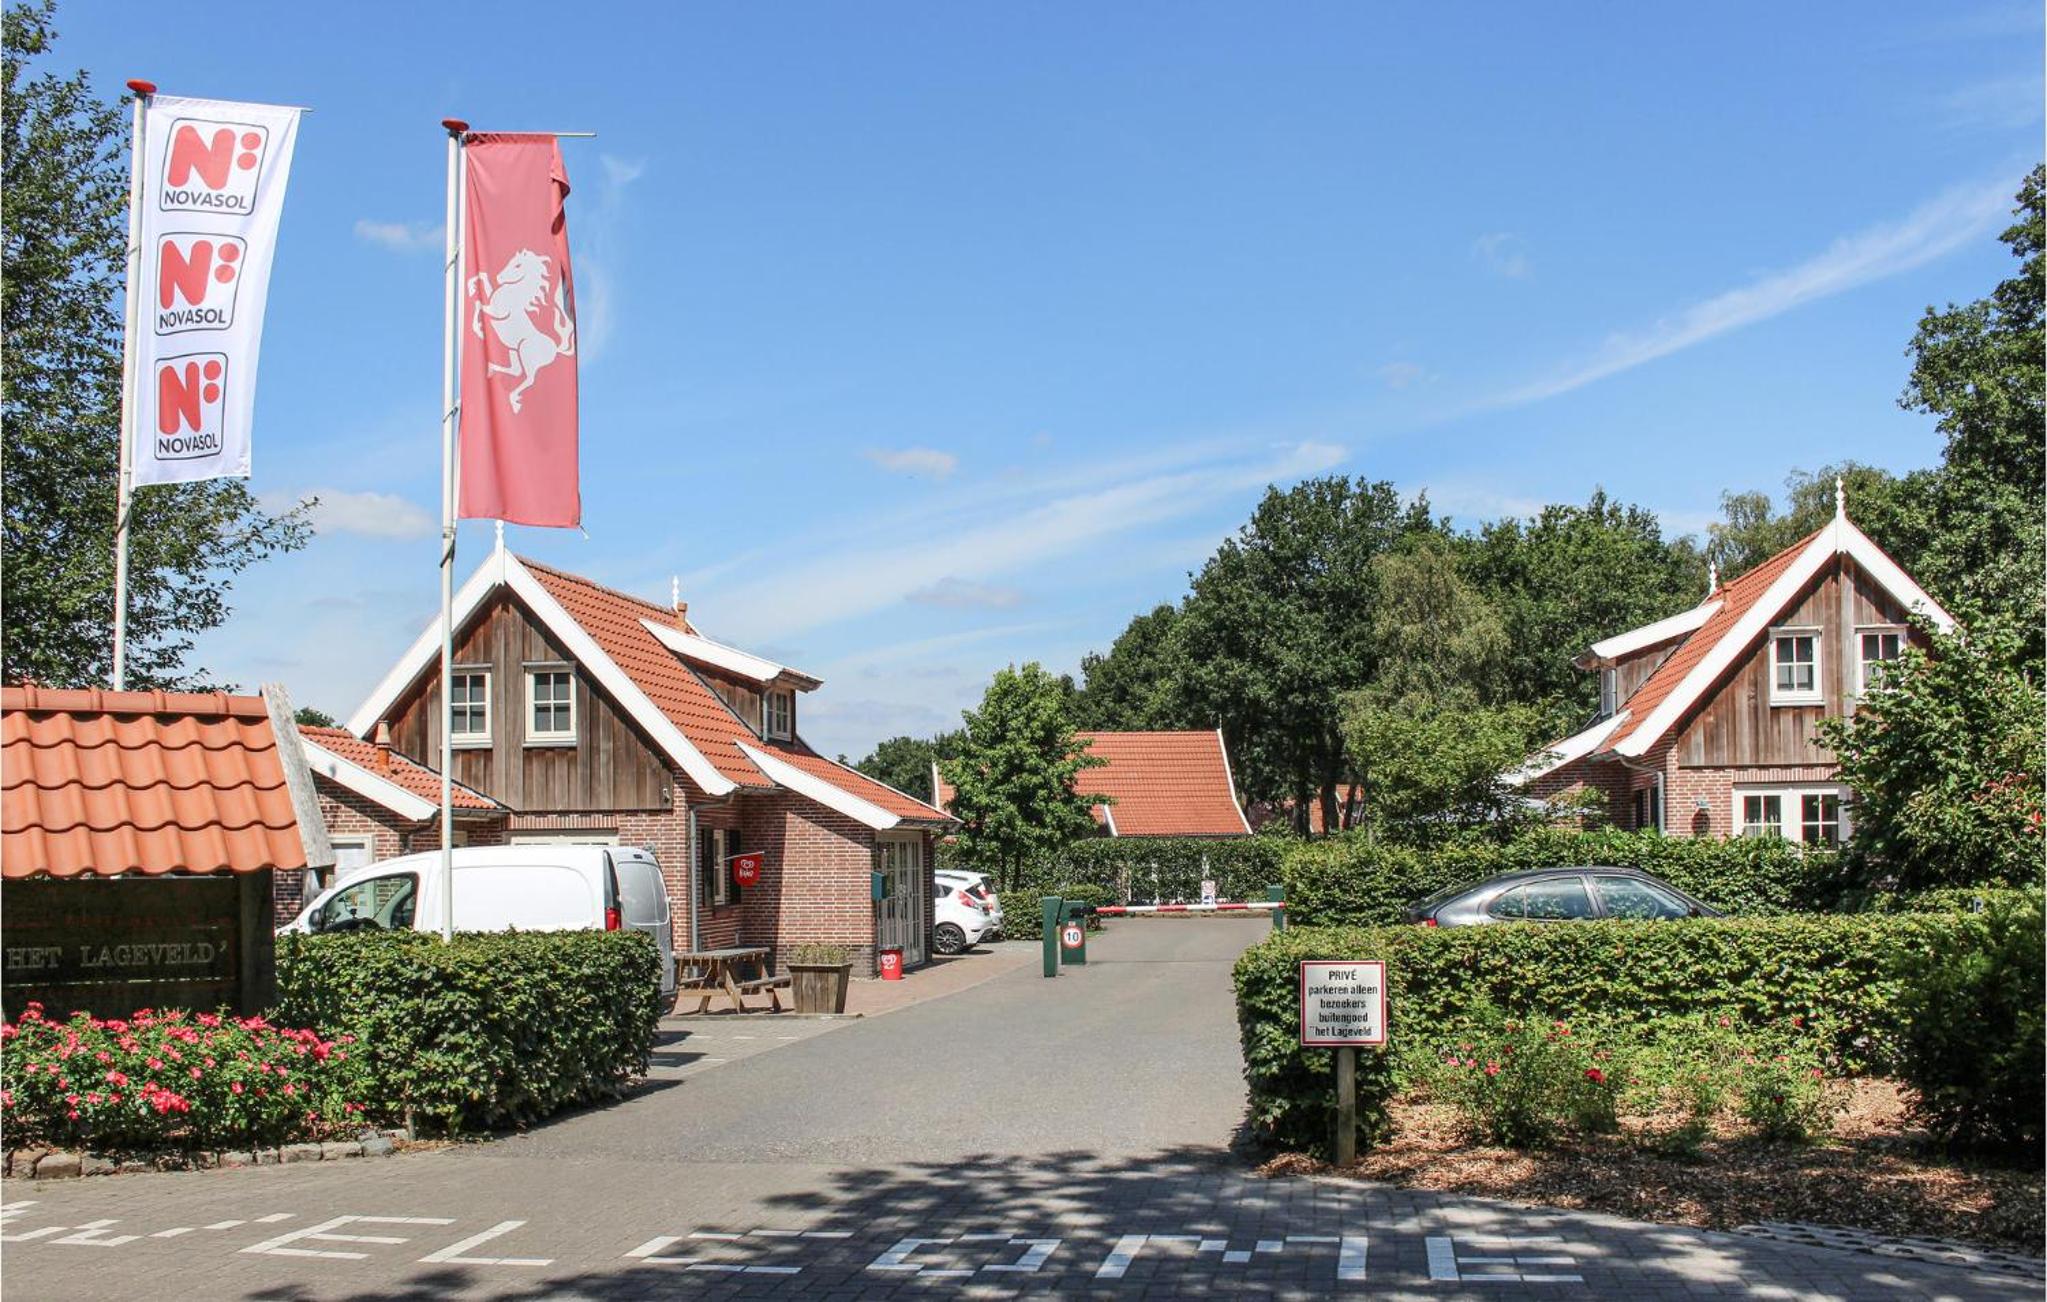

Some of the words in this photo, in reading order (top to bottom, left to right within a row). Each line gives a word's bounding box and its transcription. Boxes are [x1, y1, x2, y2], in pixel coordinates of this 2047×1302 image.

[164, 190, 248, 209] NOVASOL
[159, 308, 226, 329] NOVASOL
[158, 433, 219, 453] NOVASOL
[1067, 931, 1079, 942] 10
[5, 946, 62, 970] HET
[1328, 969, 1358, 981] PRIVÉ
[1308, 984, 1349, 997] parkeren
[1350, 984, 1378, 995] alleen
[1320, 998, 1367, 1009] bezoekers
[1319, 1012, 1368, 1024] buitengoed
